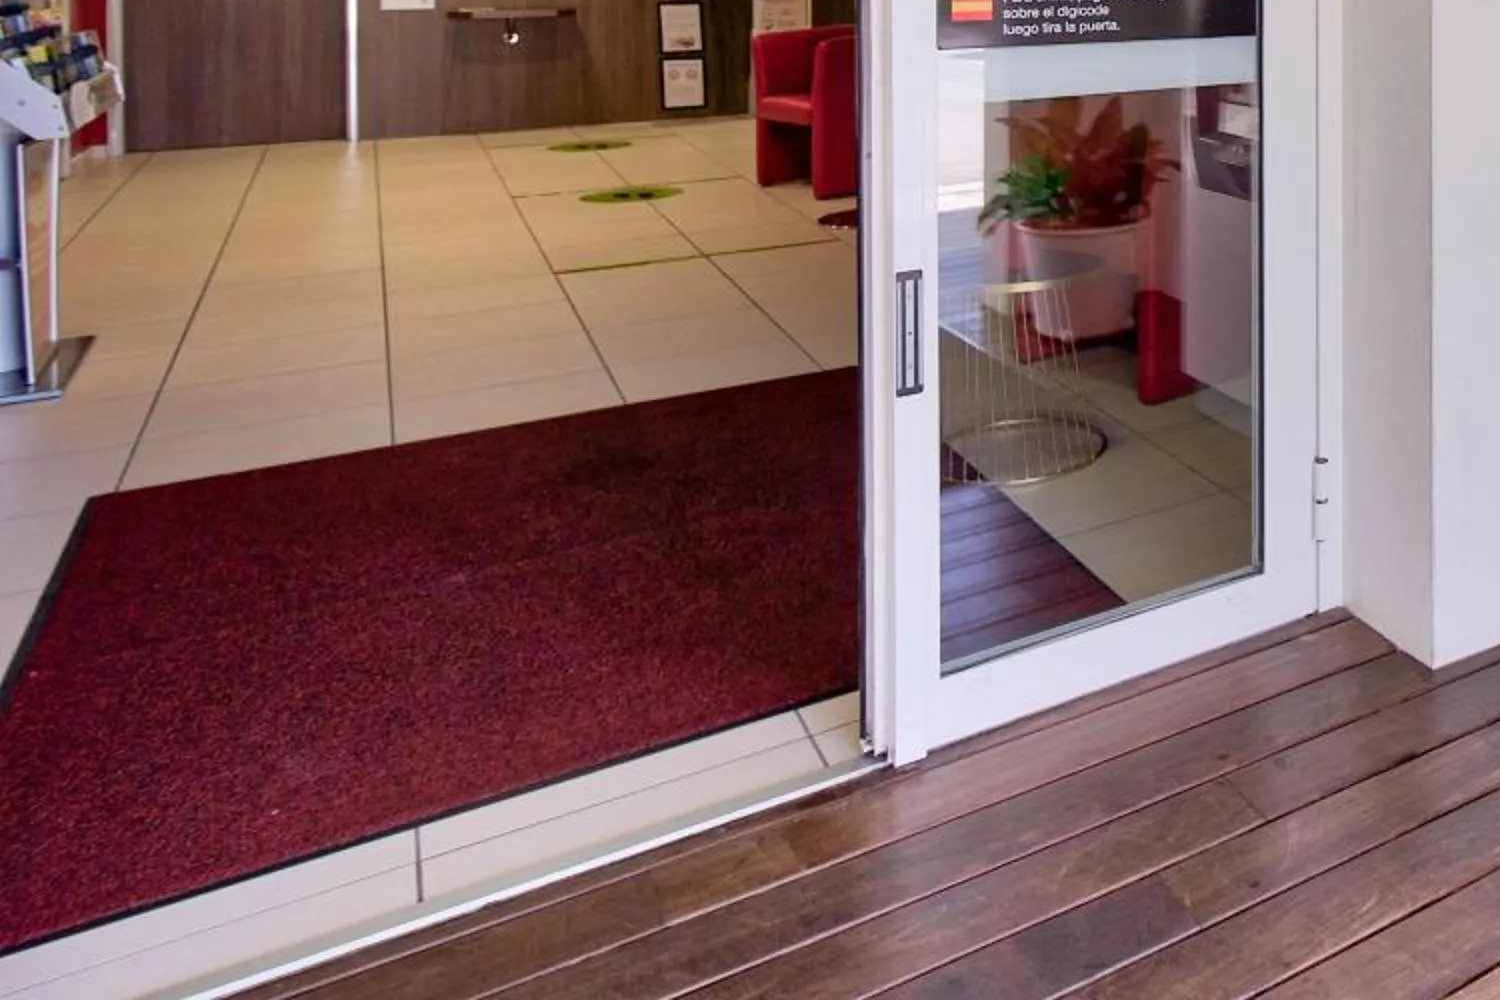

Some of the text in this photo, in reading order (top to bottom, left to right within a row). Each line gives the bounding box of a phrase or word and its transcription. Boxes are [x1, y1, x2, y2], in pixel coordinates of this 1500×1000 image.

[1003, 4, 1110, 19] sobre el digicode
[1003, 23, 1038, 36] luego
[1042, 22, 1062, 33] tira
[1066, 21, 1076, 32] la
